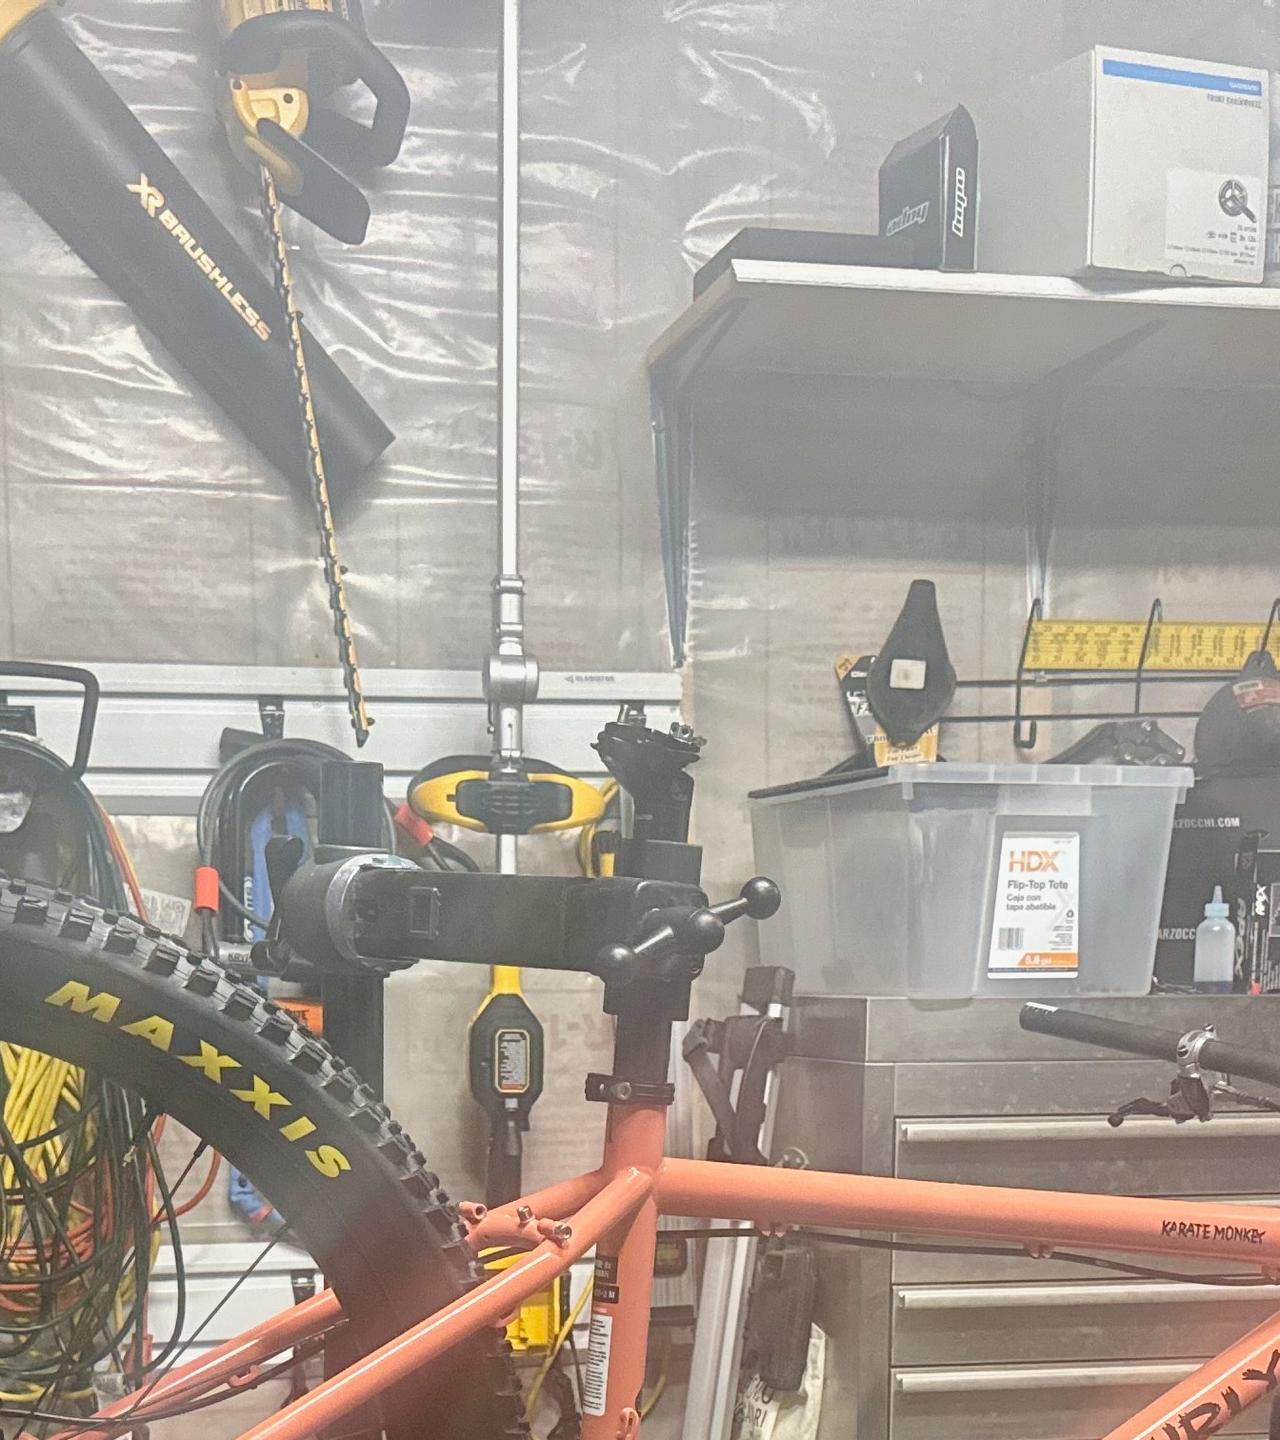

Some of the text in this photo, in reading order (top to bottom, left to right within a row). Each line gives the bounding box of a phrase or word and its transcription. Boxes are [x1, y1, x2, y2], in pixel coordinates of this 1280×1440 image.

[125, 172, 165, 218] XR
[158, 208, 273, 342] BRUSHLESS
[1173, 817, 1240, 829] RZOCCHI.COM
[1008, 850, 1060, 872] HDX
[1007, 879, 1069, 890] Flip-Top Tote
[1158, 928, 1196, 941] ARZOCC
[44, 980, 352, 1181] MAXXIS
[1161, 1220, 1266, 1245] KARATE MONKEY
